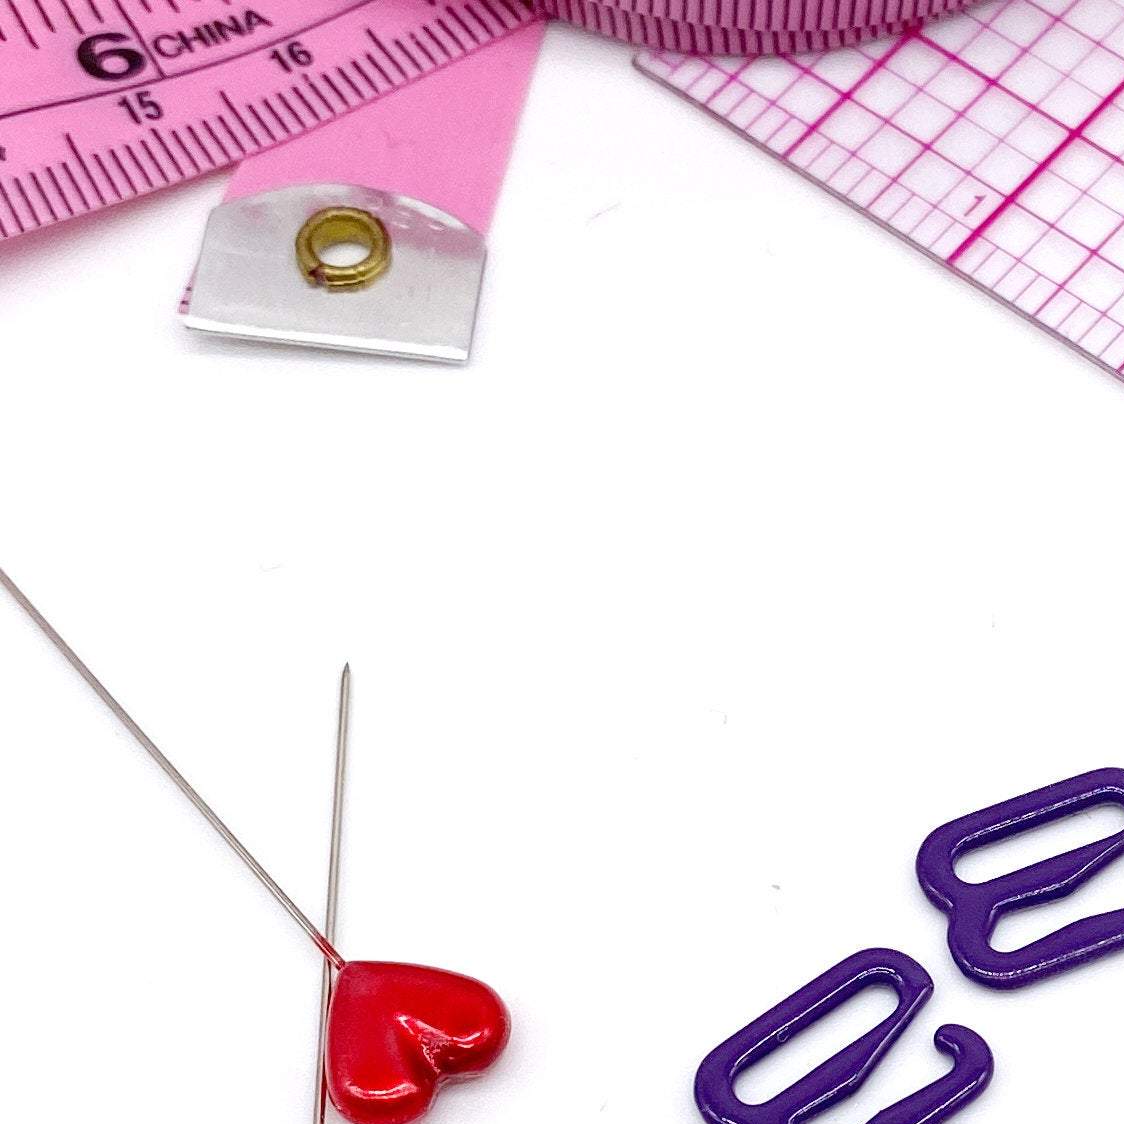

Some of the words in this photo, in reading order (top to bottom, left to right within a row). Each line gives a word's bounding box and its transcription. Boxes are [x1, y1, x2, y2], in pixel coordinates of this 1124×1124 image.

[152, 9, 274, 58] CHINA
[77, 32, 147, 81] 6
[270, 41, 315, 73] 16
[117, 90, 164, 125] 15
[964, 194, 988, 217] 1
